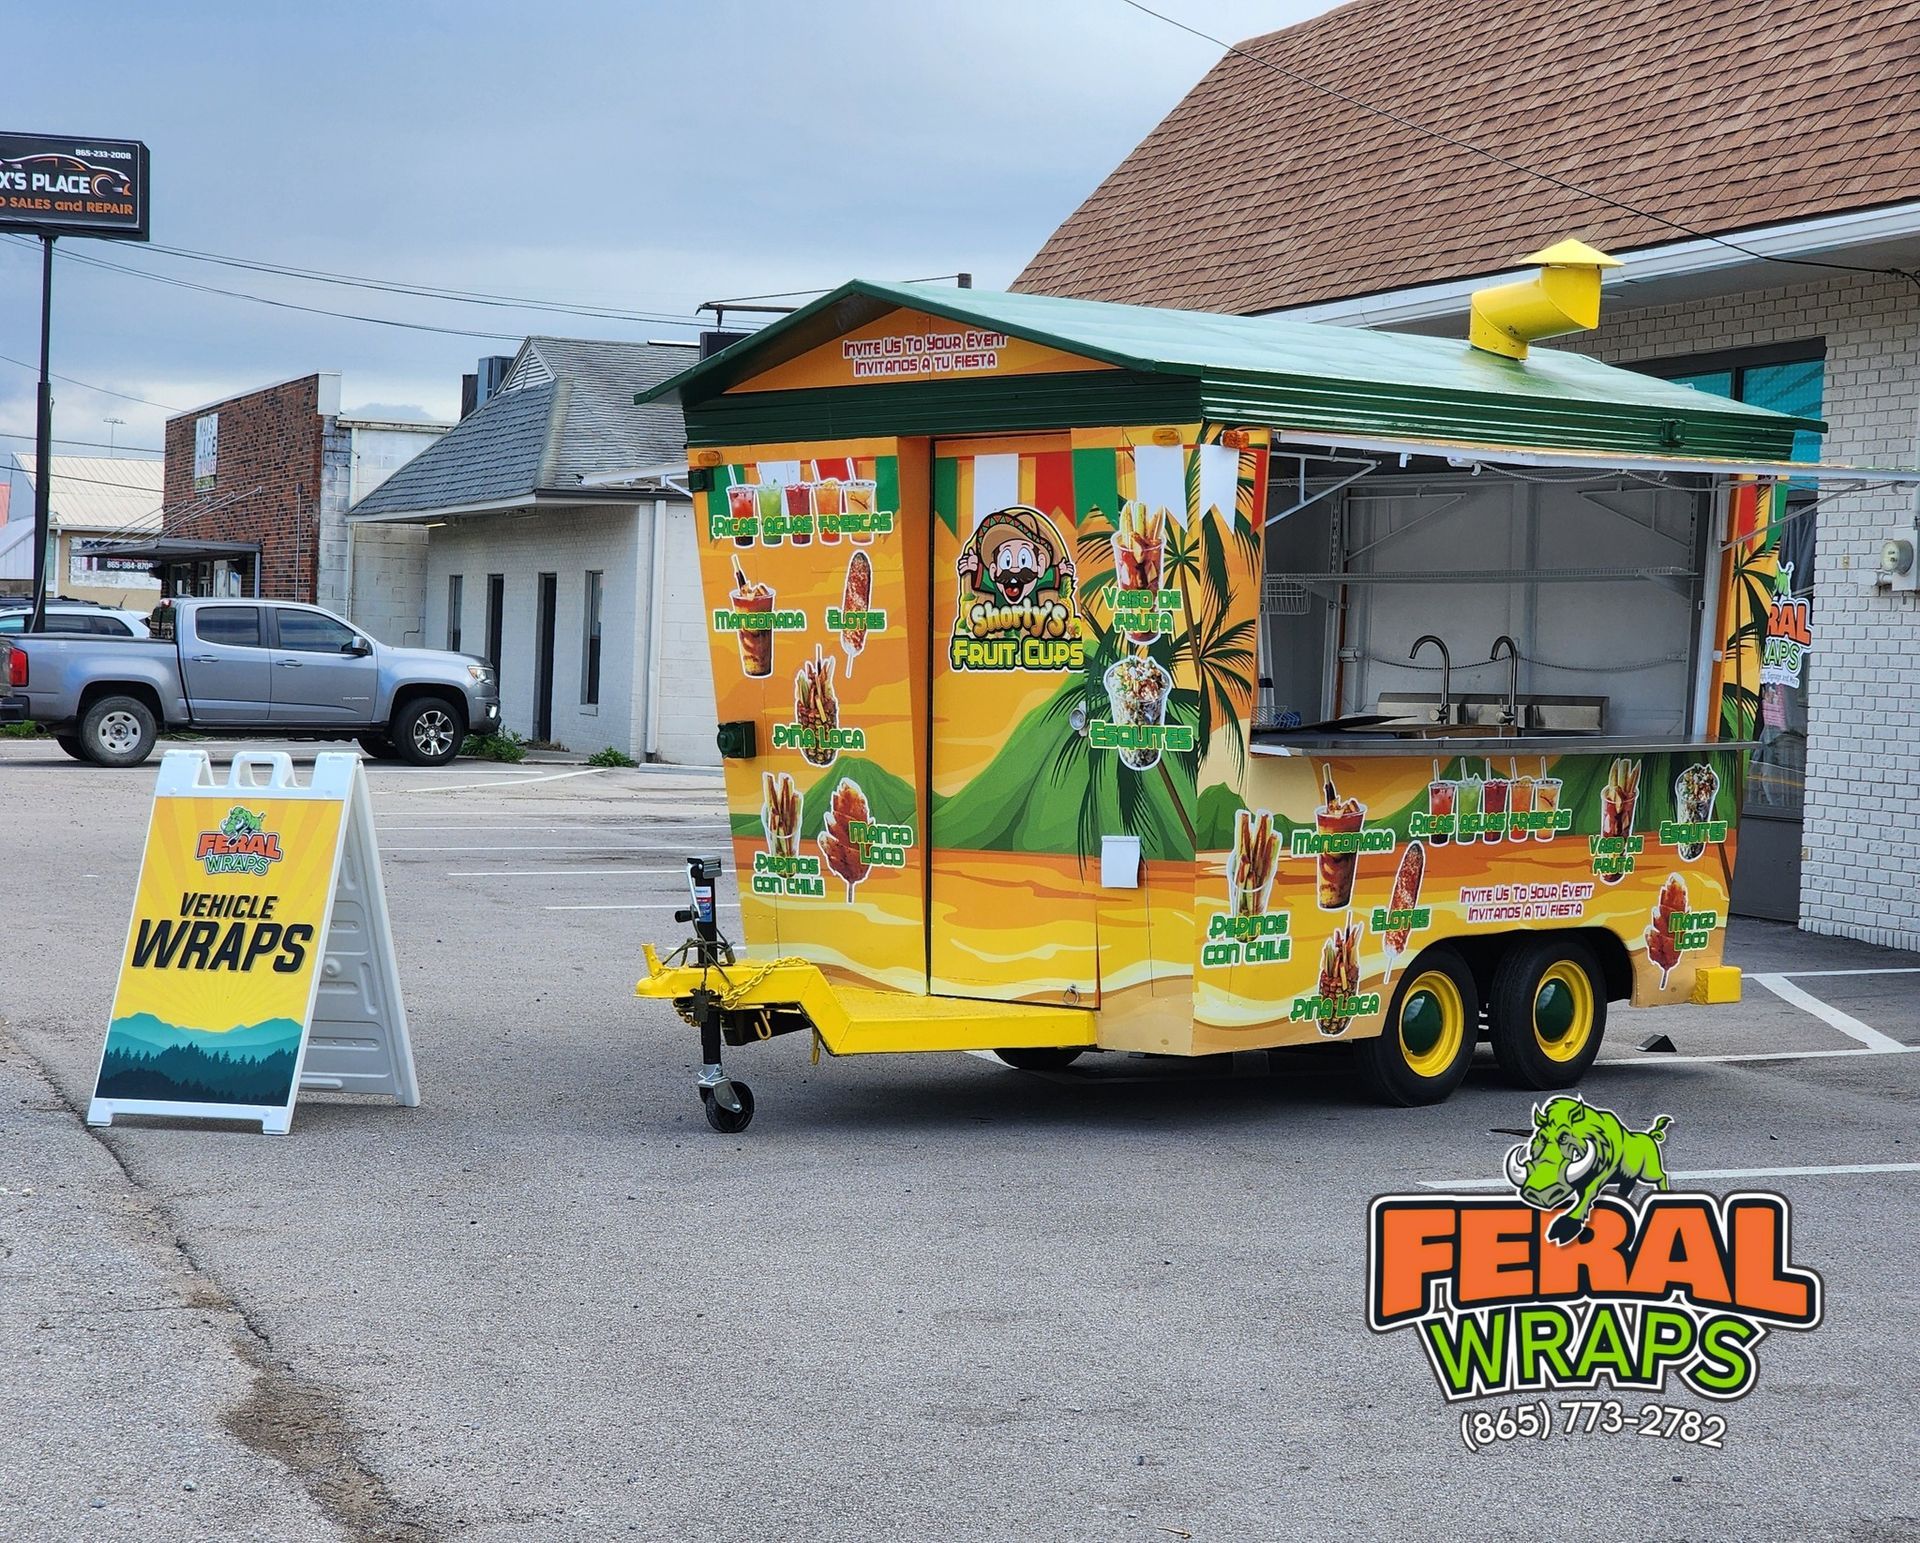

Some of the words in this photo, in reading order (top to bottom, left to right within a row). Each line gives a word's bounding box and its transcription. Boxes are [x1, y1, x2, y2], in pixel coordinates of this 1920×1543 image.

[75, 149, 132, 159] 865-233-2008
[0, 172, 27, 190] X'S
[32, 173, 91, 194] PLACE
[10, 197, 51, 210] SALES
[55, 200, 82, 212] and
[86, 202, 133, 215] REPAIR
[844, 341, 881, 357] INVITE
[884, 340, 901, 353] US
[906, 337, 922, 352] TO
[927, 335, 962, 351] YOUR
[966, 333, 1008, 348] EVENT
[855, 359, 918, 376] INVITANOS
[921, 359, 931, 371] A
[935, 356, 949, 369] TU
[954, 353, 996, 368] FIESTA
[713, 516, 759, 538] RICAS
[763, 515, 813, 535] AGUAS
[818, 512, 893, 534] FRESCAS
[1103, 588, 1156, 609] VASO
[1158, 590, 1182, 610] DE
[714, 610, 806, 631] MANGONADA
[827, 609, 886, 631] ELOTES
[1114, 613, 1174, 634] FRUTA
[1767, 603, 1811, 646] RAL
[952, 639, 1017, 666] FRUIT
[1023, 638, 1085, 666] CUPS
[1763, 639, 1801, 672] APS
[774, 725, 812, 748] PIÑA
[819, 727, 865, 750] LOCA
[1090, 721, 1193, 752] ESQUITES
[850, 822, 913, 847] MANGO
[1410, 812, 1455, 836] RICAS
[1458, 813, 1506, 833] AGUAS
[1509, 810, 1572, 830] FRESCAS
[1660, 821, 1728, 845] ESQUITES
[197, 832, 282, 860] FERAL
[1292, 831, 1395, 855] MANGONADA
[1590, 835, 1625, 855] VASO
[206, 855, 269, 874] WRAPS
[755, 853, 820, 875] PEPINOS
[860, 844, 905, 867] LOCO
[1593, 857, 1635, 875] FRUTA
[753, 877, 783, 894] CON
[786, 878, 824, 896] CHILE
[1461, 888, 1492, 903] INVITE
[1495, 887, 1509, 901] US
[1514, 886, 1527, 900] TO
[1531, 885, 1558, 899] YOUR
[1561, 884, 1593, 898] EVENT
[179, 892, 278, 919] VEHICLE
[1468, 906, 1521, 921] INVITANOS
[1524, 905, 1532, 917] A
[1535, 905, 1546, 917] TU
[1550, 903, 1583, 917] FIESTA
[1209, 913, 1290, 939] PEPINOS
[1371, 908, 1431, 933] ELOTES
[1669, 911, 1717, 932] MANGO
[131, 920, 315, 974] WRAPS
[1675, 931, 1709, 950] LOCO
[1203, 943, 1240, 967] CON
[1245, 939, 1291, 962] CHILE
[1290, 997, 1332, 1021] PIÑA
[1337, 993, 1380, 1018] LOCA
